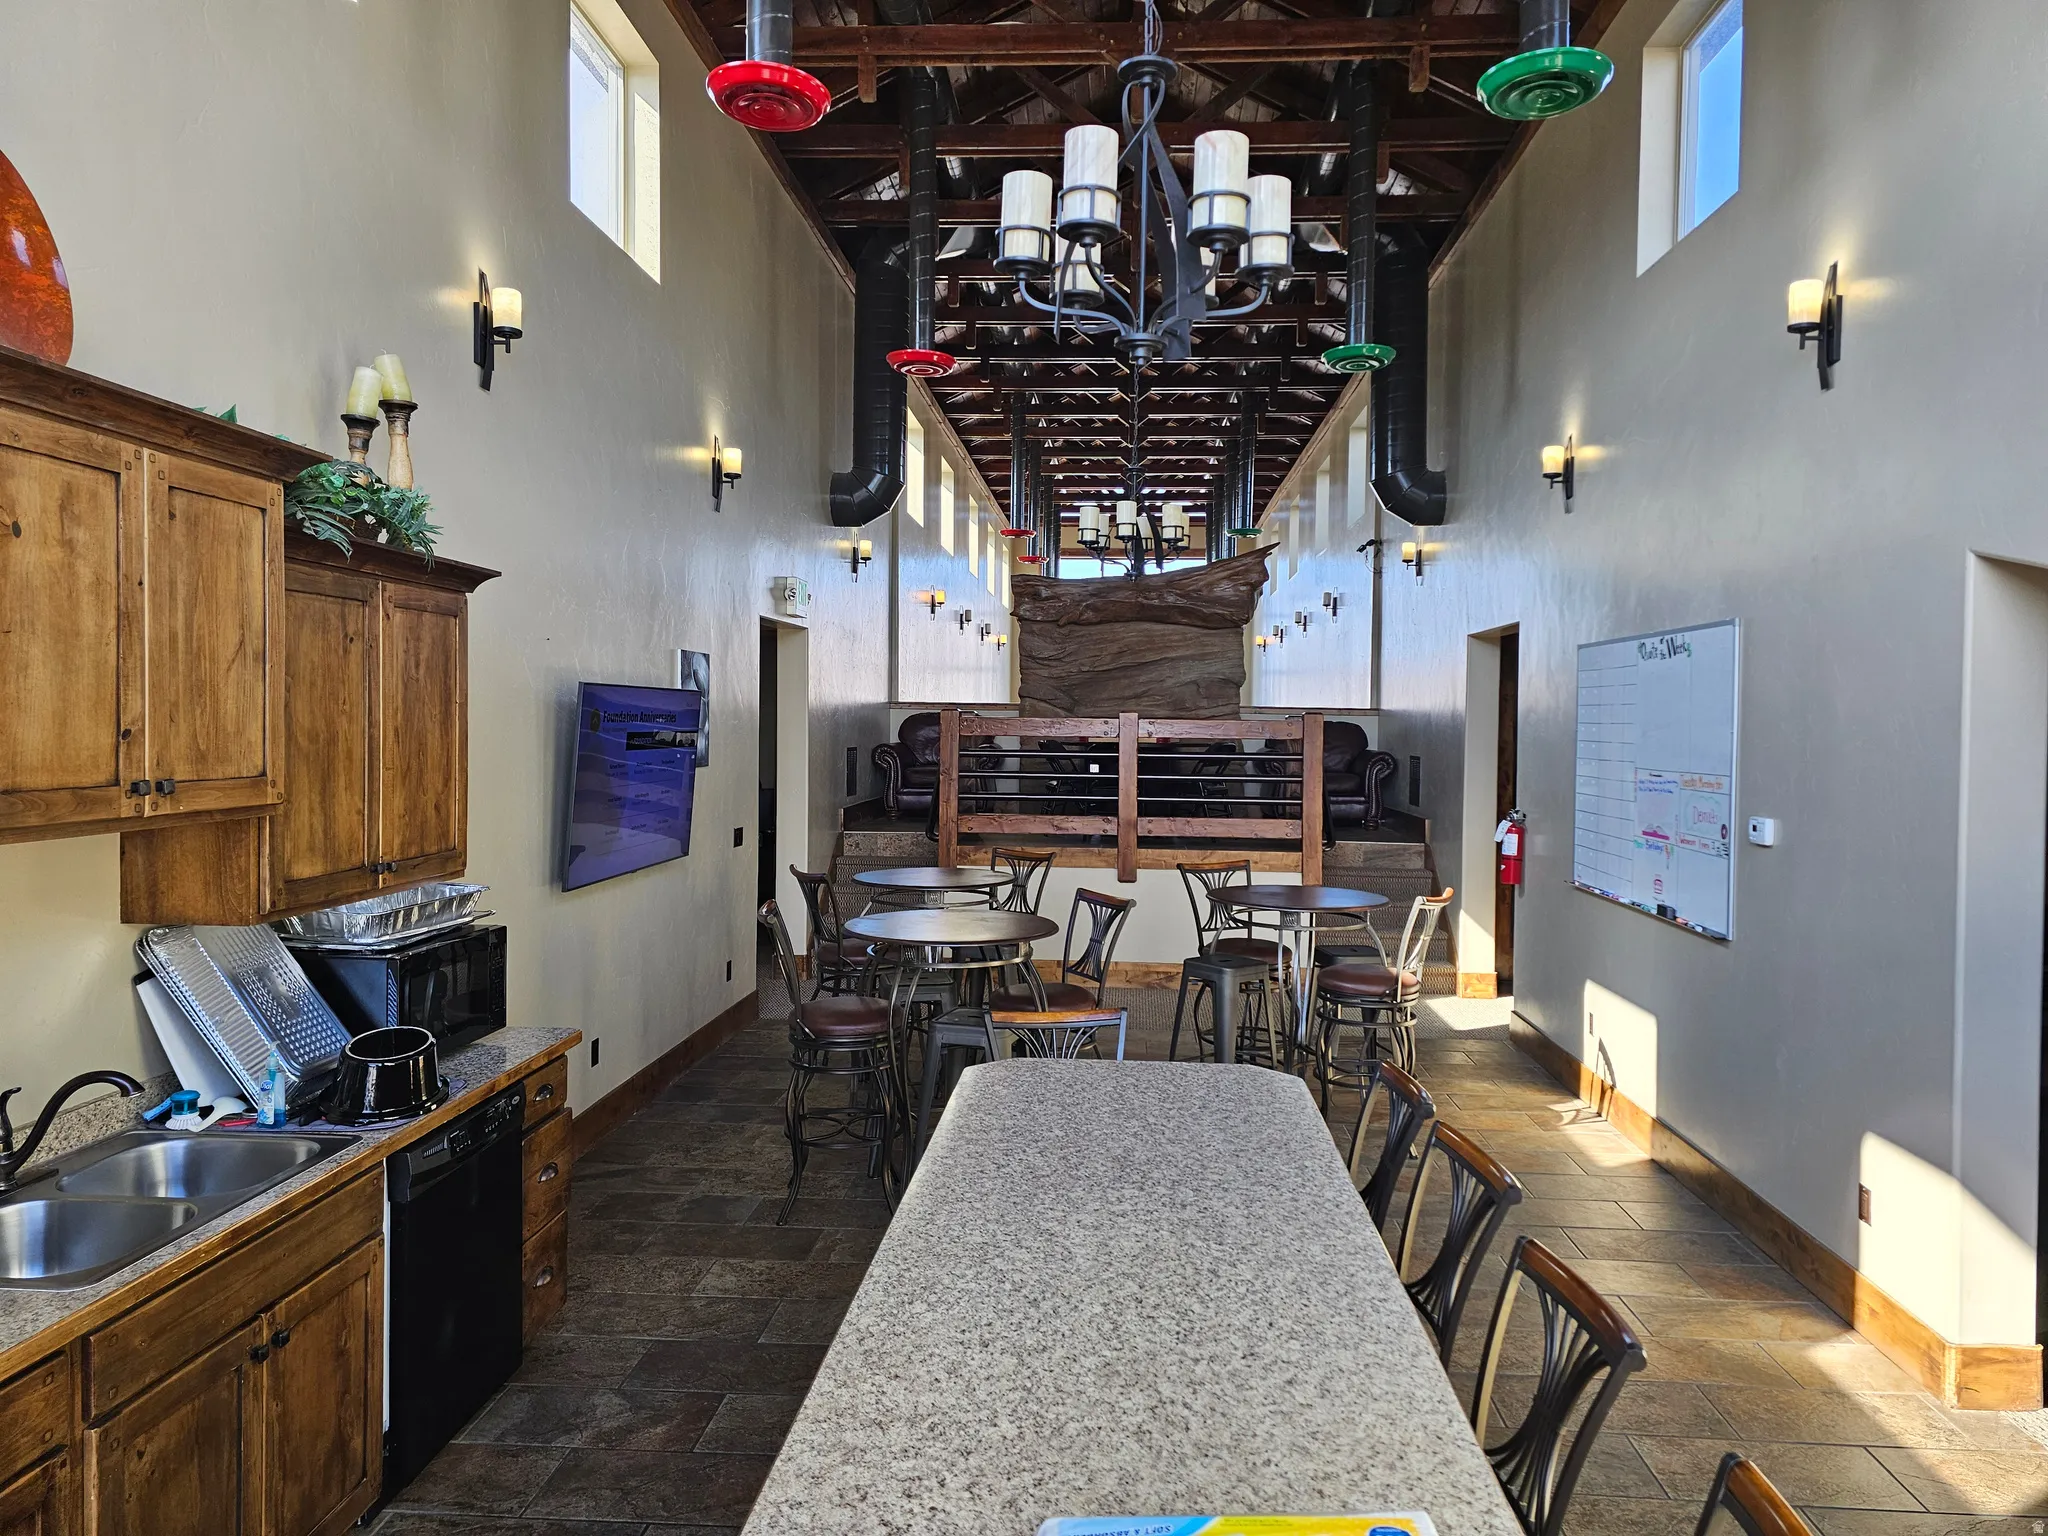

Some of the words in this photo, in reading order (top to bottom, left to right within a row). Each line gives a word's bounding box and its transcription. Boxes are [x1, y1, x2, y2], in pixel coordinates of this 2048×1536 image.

[603, 710, 639, 723] Foundation
[639, 710, 677, 723] Anniversaries
[1145, 1525, 1171, 1535] SOFT
